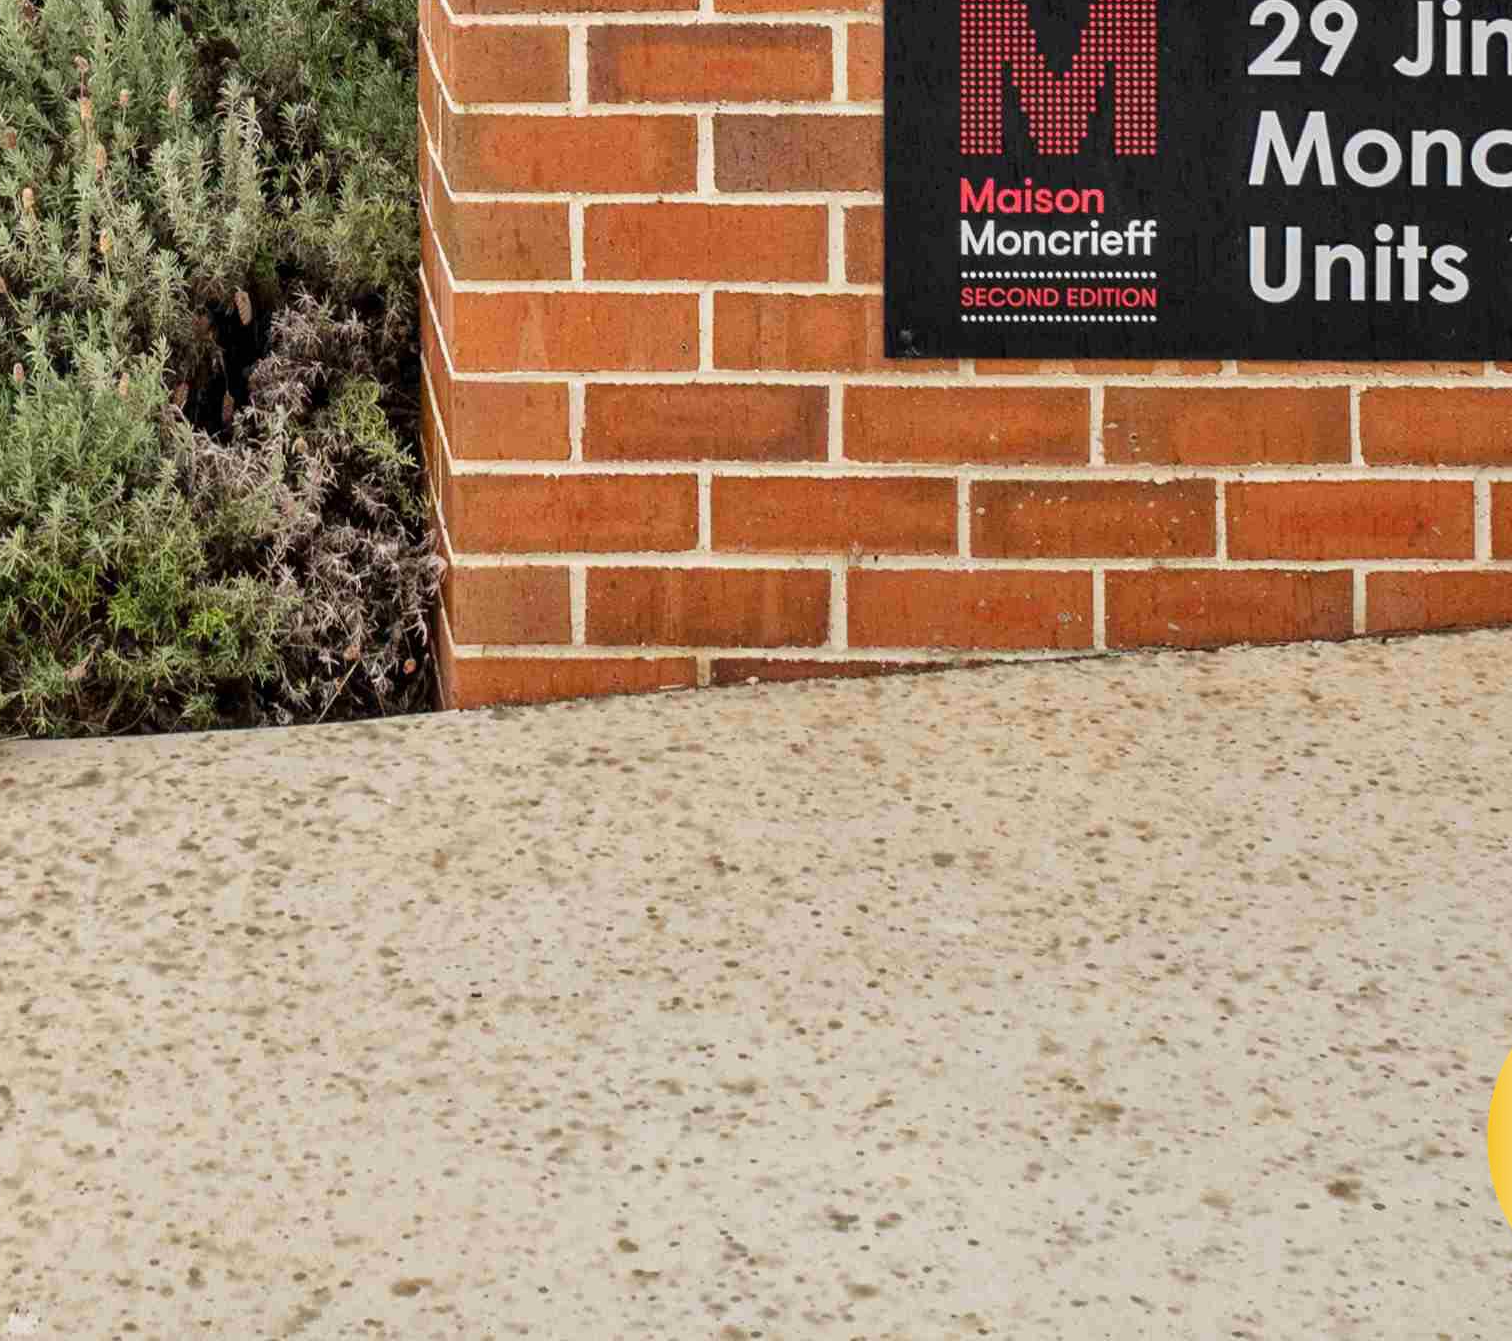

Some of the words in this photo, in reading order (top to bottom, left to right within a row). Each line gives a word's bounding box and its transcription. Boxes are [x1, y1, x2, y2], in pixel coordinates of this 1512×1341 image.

[1248, 0, 1358, 76] 29
[960, 177, 1104, 213] Maison
[961, 220, 1156, 255] Moncrieff
[1250, 224, 1469, 302] Units
[960, 286, 1061, 309] SECOND
[1065, 285, 1158, 310] EDITION
